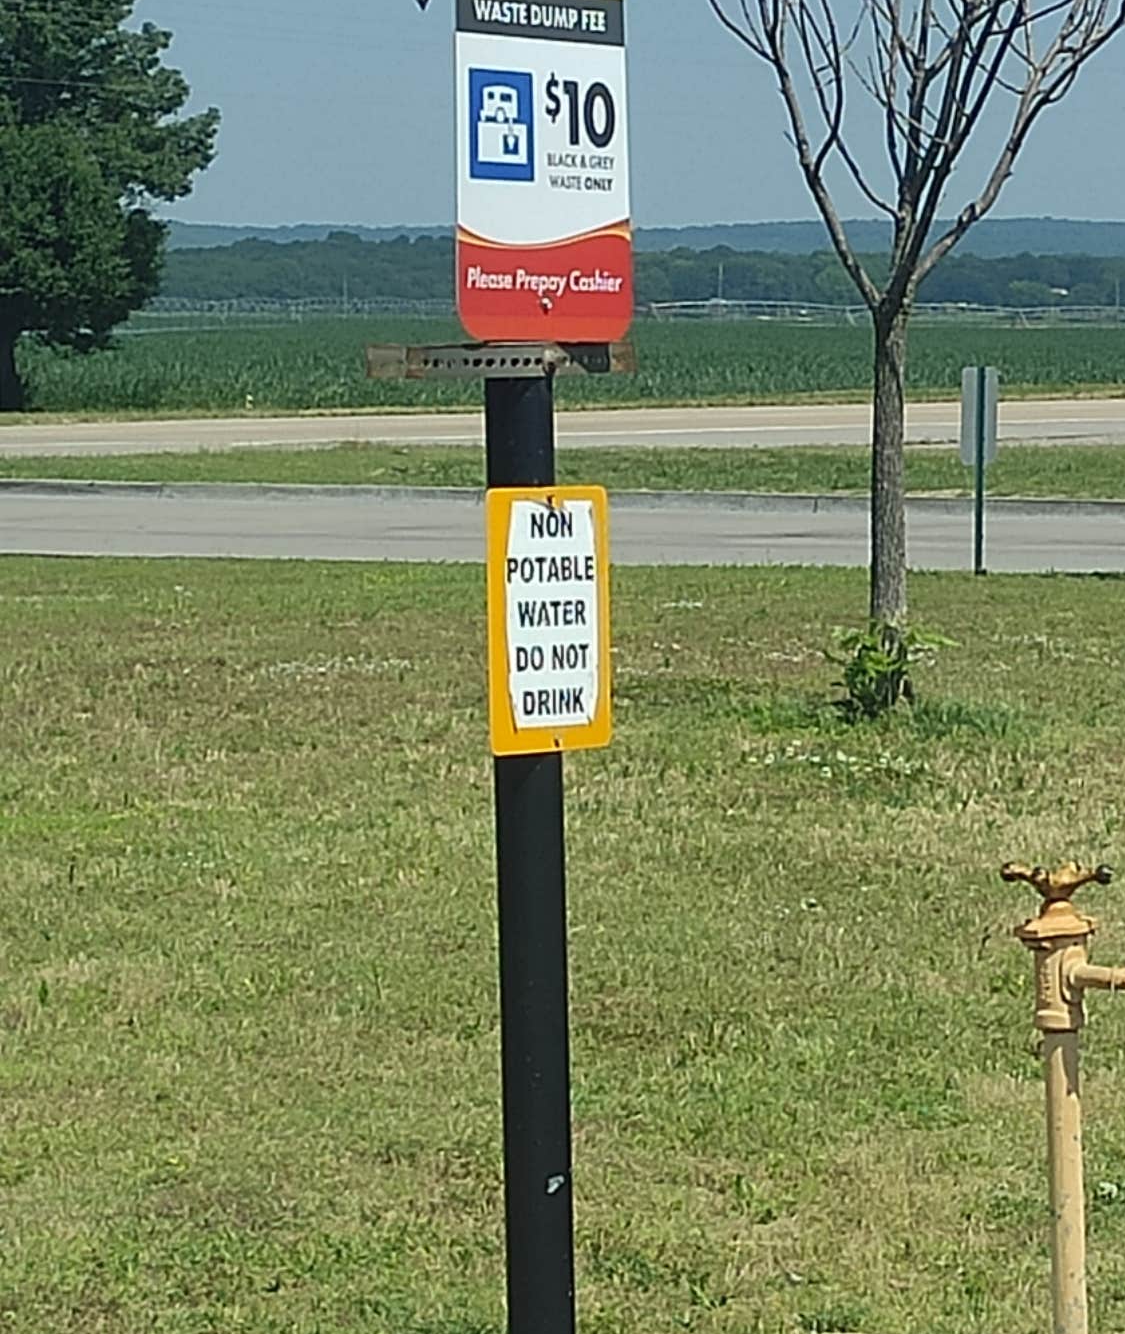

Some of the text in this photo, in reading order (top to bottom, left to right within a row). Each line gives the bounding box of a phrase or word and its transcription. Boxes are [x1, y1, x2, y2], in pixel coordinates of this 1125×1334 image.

[530, 4, 578, 29] DUMP
[581, 9, 606, 33] FEE
[545, 72, 615, 148] $10
[547, 153, 615, 170] BLACK & GREY
[549, 175, 613, 191] WASTE ONLY
[466, 266, 622, 297] Please Prepay Cashier
[530, 511, 574, 539] NON
[506, 555, 595, 584] POTABLE
[517, 600, 587, 628] WATER
[516, 643, 590, 673] DO NOT
[523, 686, 585, 716] DRINK
